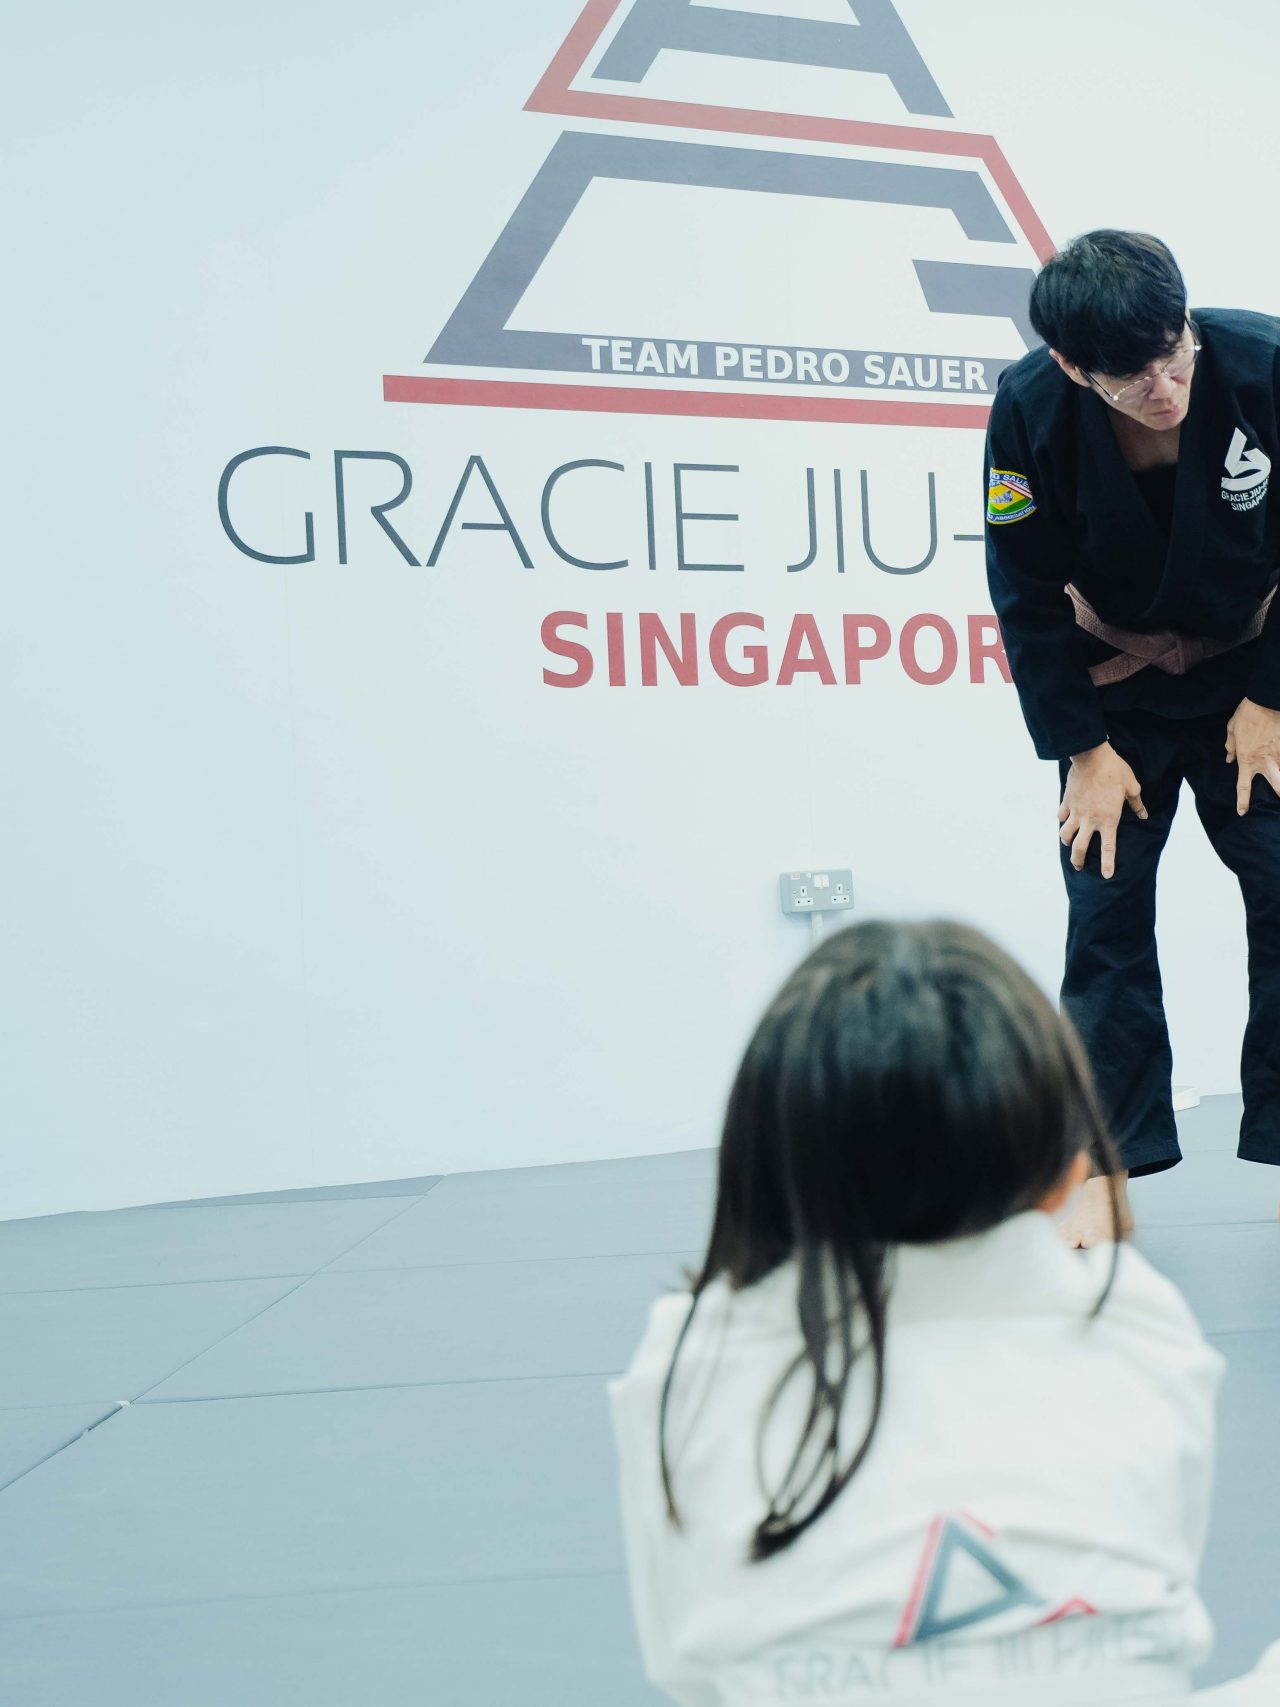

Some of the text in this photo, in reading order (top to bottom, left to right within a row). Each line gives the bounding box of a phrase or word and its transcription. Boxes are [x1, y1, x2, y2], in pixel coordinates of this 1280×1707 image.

[582, 338, 988, 391] TEAM PEDRO SAUER
[1003, 474, 1030, 489] SAUE
[1221, 490, 1250, 502] GRACIE
[217, 446, 985, 576] GRACIE JIU-
[540, 610, 1014, 688] SINGAPOR
